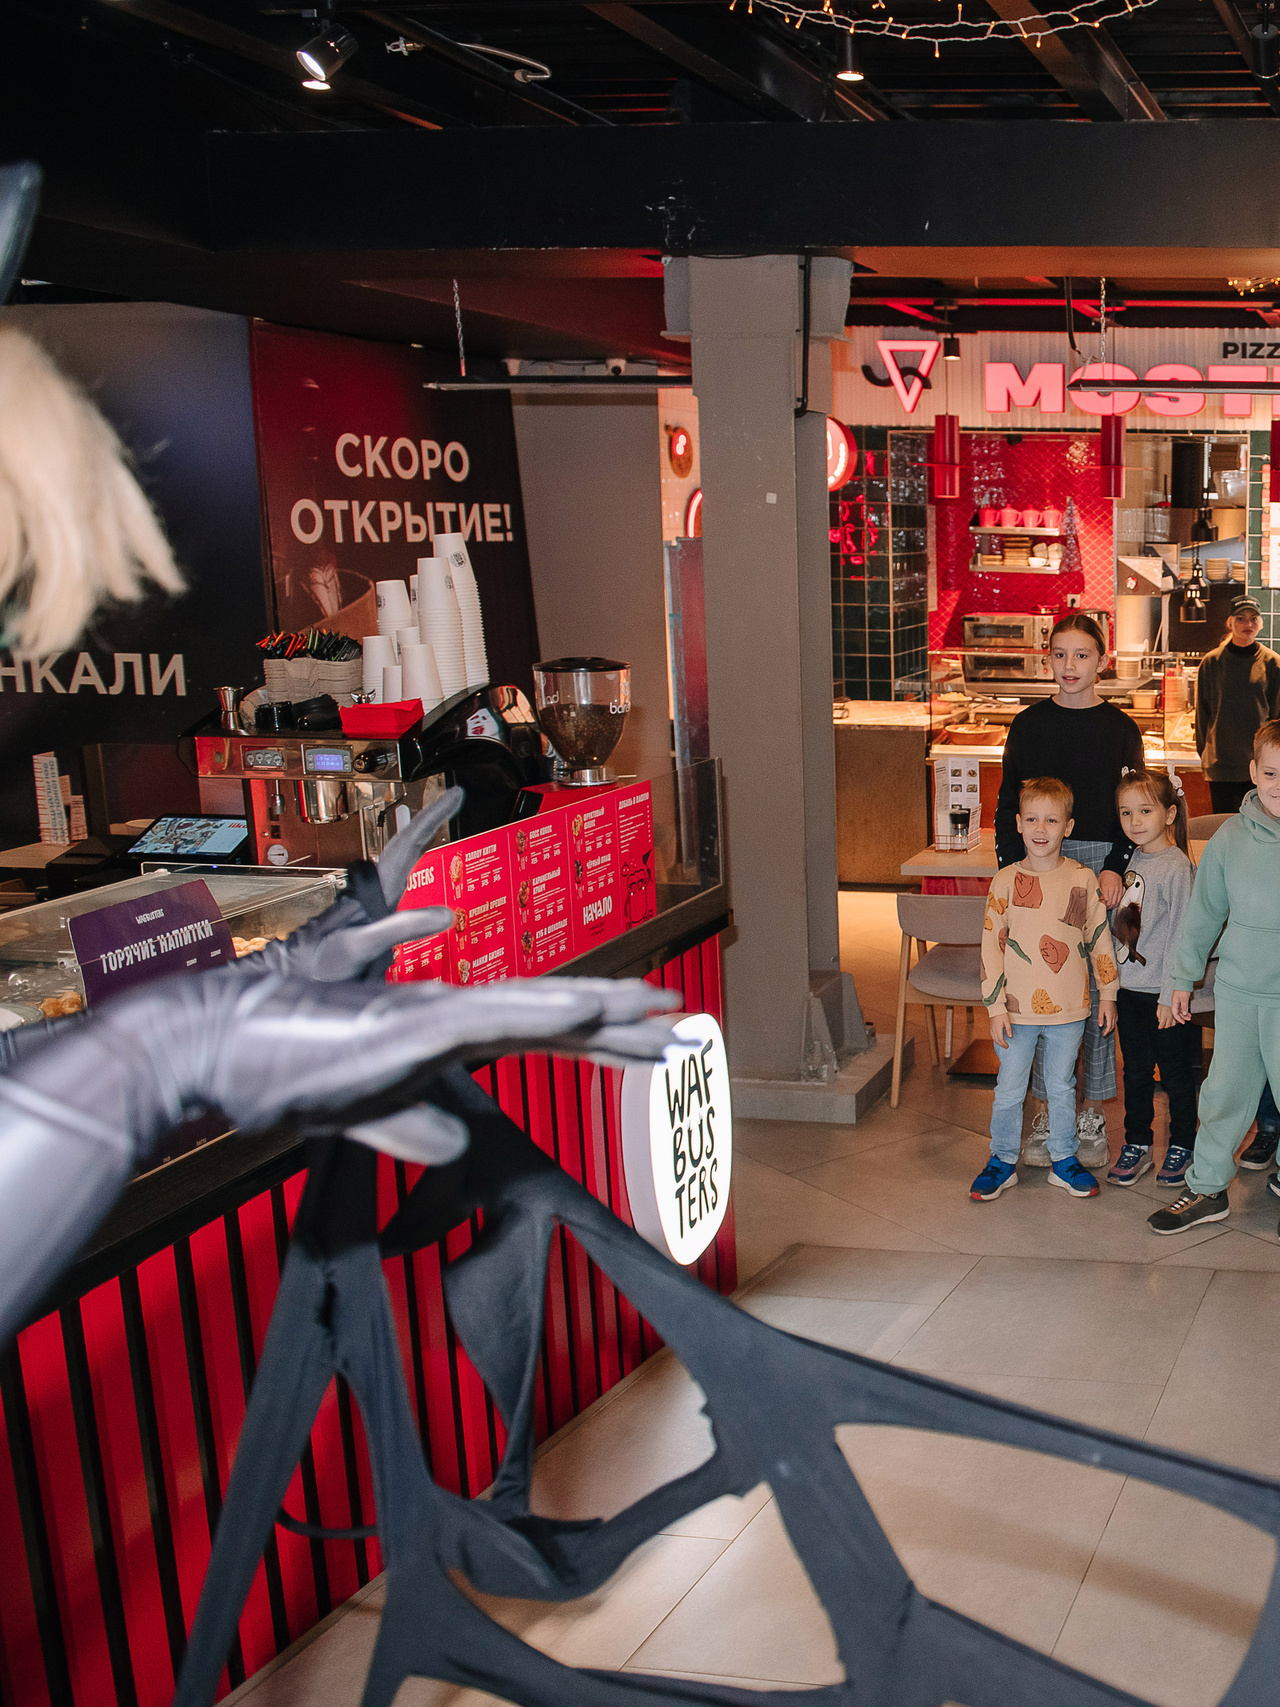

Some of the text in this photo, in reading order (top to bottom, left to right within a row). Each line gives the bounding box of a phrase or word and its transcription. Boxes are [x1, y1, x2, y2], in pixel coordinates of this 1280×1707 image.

[335, 432, 470, 482] СКОРО
[290, 498, 514, 545] ОТКРЫТИЕ!
[99, 919, 214, 975] ГОРЯЧИЕ НАПИТКИ
[665, 1039, 713, 1129] WAF
[673, 1106, 715, 1183] BUS
[675, 1158, 718, 1239] TERS
